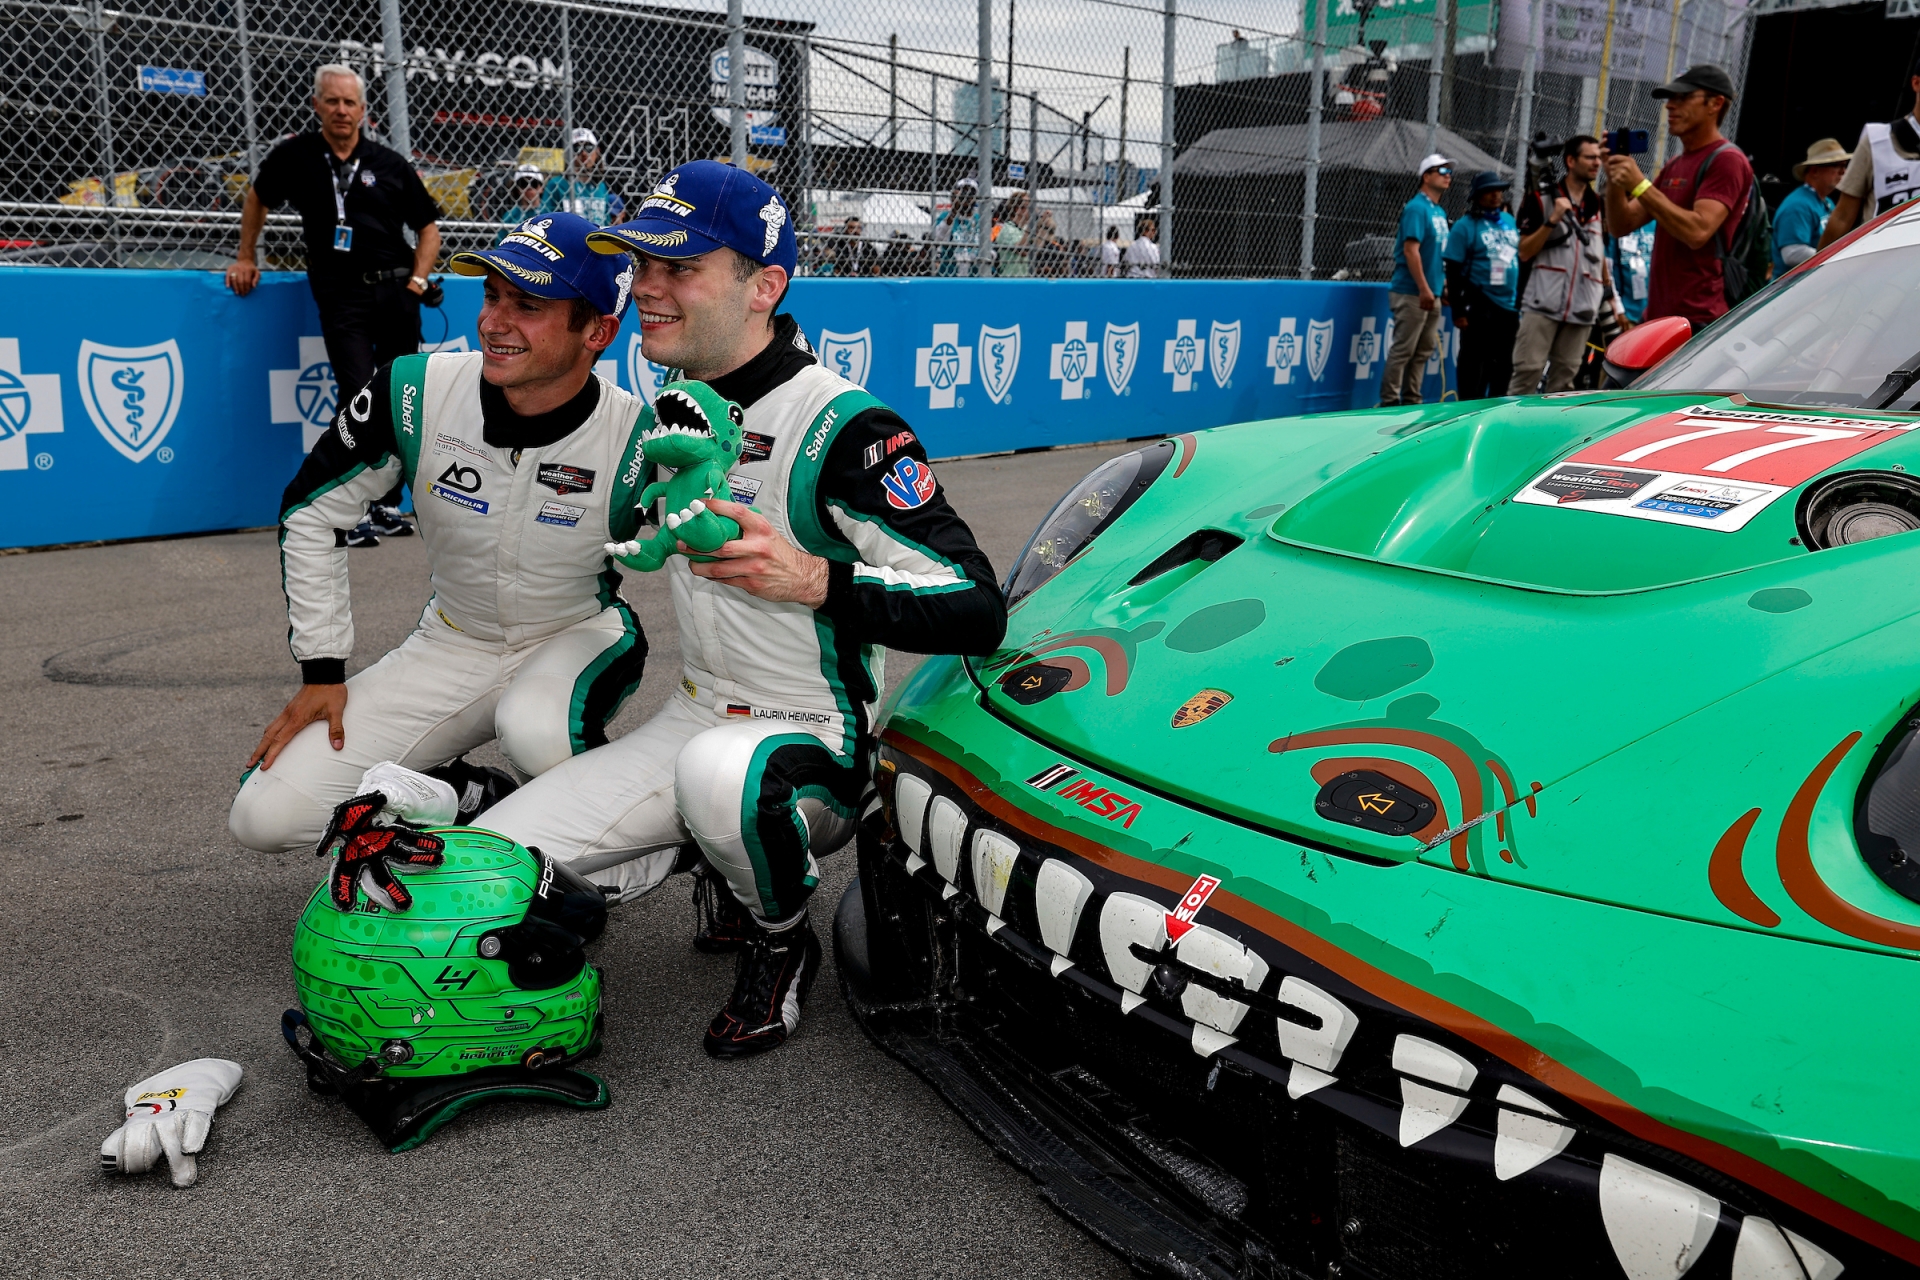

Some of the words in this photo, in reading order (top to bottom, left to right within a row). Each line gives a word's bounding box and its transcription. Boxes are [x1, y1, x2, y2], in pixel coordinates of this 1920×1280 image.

[710, 84, 778, 101] INCAR
[402, 384, 417, 436] Sabelt
[804, 405, 839, 461] Sabelt
[886, 431, 917, 455] IMS
[1611, 418, 1866, 473] 77
[540, 471, 593, 485] WeatherTech
[881, 456, 920, 508] VP
[1551, 473, 1641, 489] WeatherTech
[442, 491, 485, 510] MICHELIN
[753, 709, 788, 721] LAURIN
[788, 712, 831, 725] HEINRICH
[1056, 778, 1143, 830] IMSA
[1175, 879, 1213, 923] TOW
[459, 1050, 517, 1060] Heinrich
